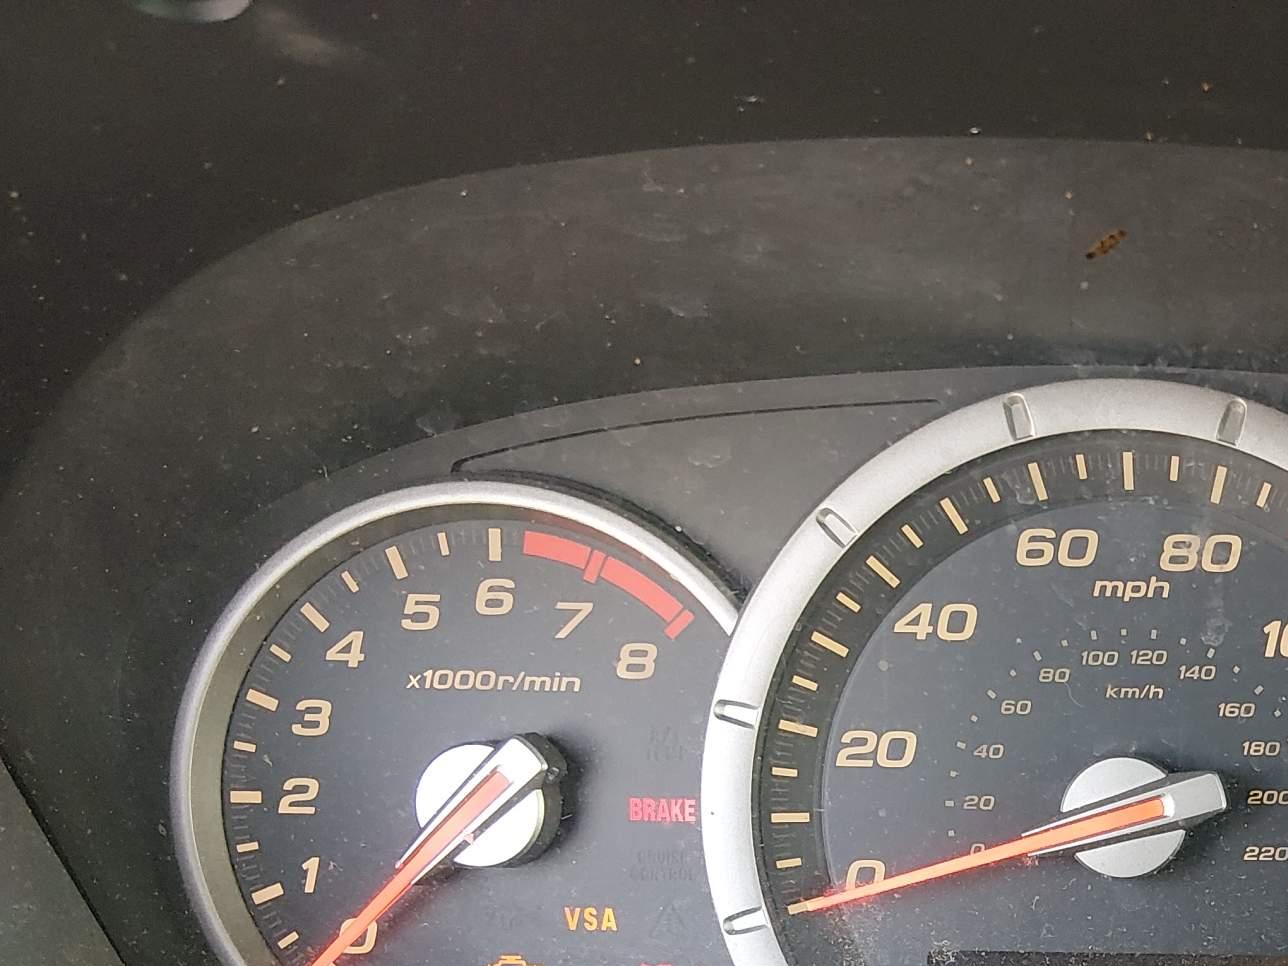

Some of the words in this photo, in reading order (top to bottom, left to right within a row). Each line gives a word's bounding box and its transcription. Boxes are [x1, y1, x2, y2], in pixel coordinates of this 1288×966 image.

[1015, 528, 1099, 567] 60
[1159, 534, 1243, 573] 80
[476, 578, 516, 615] 6
[1092, 576, 1170, 602] mph
[400, 594, 440, 630] 5
[554, 602, 593, 639] 7
[893, 602, 978, 641] 40
[326, 631, 365, 667] 4
[616, 643, 657, 679] 8
[1081, 651, 1118, 666] 100
[1130, 650, 1168, 665] 120
[406, 669, 581, 692] x1000r/min
[1038, 668, 1070, 683] 80
[1178, 665, 1216, 680] 140
[1105, 684, 1164, 700] km/h
[292, 699, 332, 736] 3
[1000, 700, 1032, 715] 60
[1217, 703, 1256, 718] 160
[835, 730, 917, 768] 20
[973, 744, 1004, 759] 40
[1242, 741, 1280, 757] 180
[278, 778, 320, 814] 2
[963, 795, 995, 811] 20
[629, 798, 696, 821] BRAKE
[302, 857, 320, 893] 1
[564, 907, 617, 931] VSA
